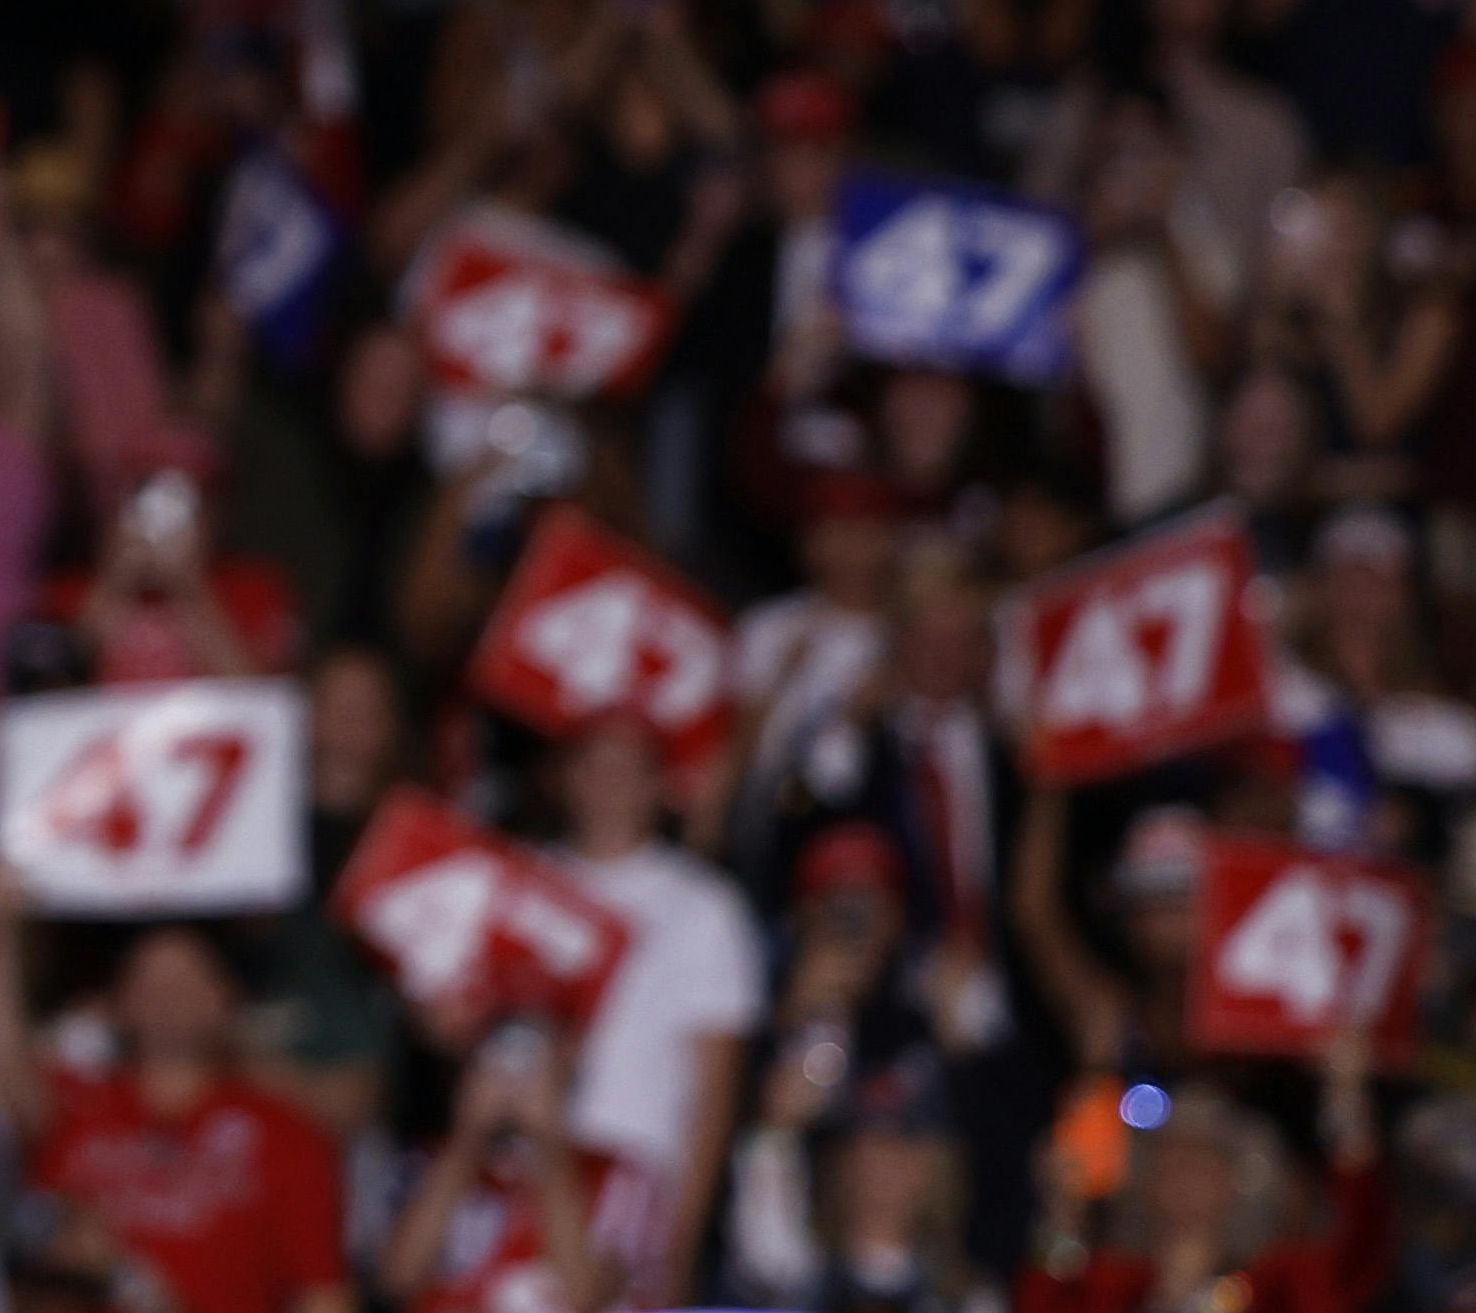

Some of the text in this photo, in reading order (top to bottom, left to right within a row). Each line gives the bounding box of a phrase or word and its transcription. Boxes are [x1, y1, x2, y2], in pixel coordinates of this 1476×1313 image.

[432, 275, 655, 397] 47
[848, 190, 1062, 347] 47
[515, 578, 728, 729] 47
[1042, 558, 1228, 730] 47
[42, 733, 254, 860] 47
[1218, 873, 1410, 1025] 47
